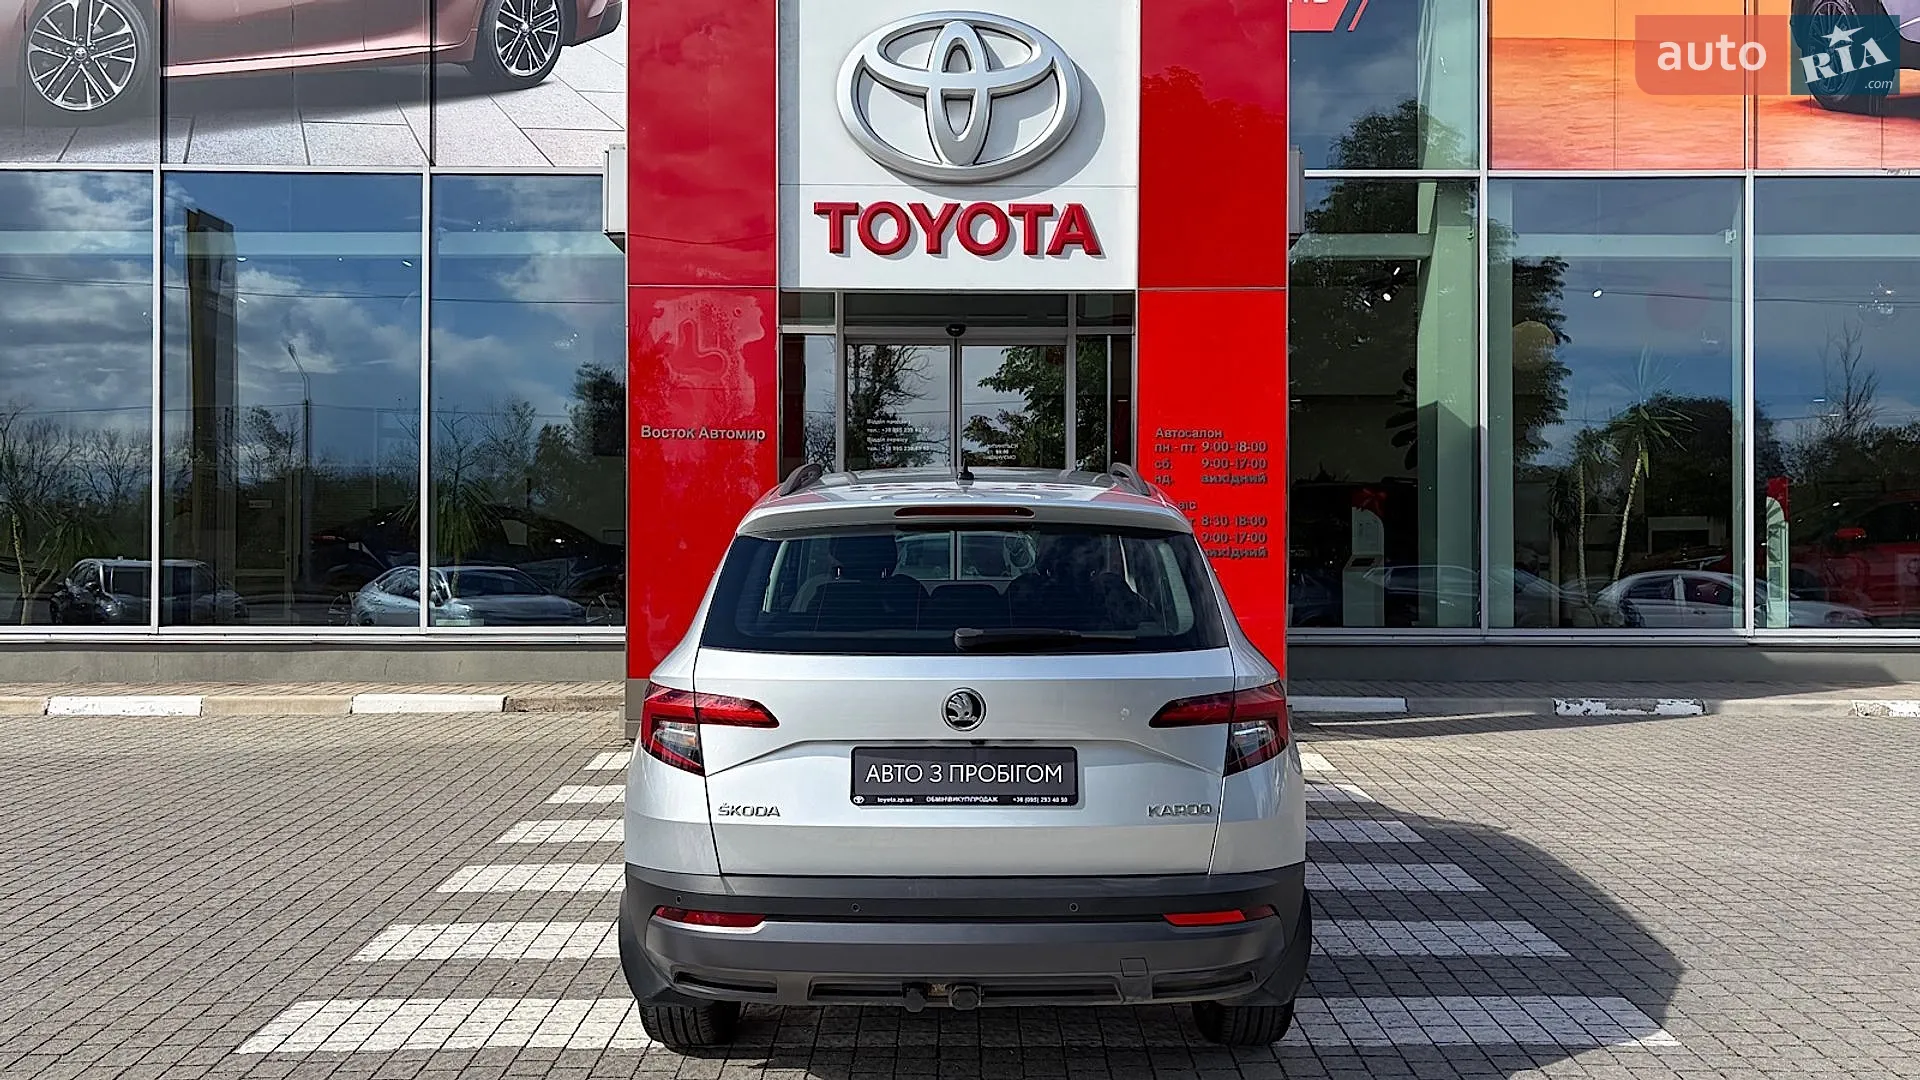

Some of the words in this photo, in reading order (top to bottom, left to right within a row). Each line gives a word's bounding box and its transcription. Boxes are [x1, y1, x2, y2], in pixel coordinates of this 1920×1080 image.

[814, 201, 1102, 256] TOYOTA
[641, 425, 695, 439] Восток
[699, 426, 766, 442] Автомир
[1155, 427, 1223, 439] Автосалон
[865, 764, 923, 783] АВТО
[929, 764, 943, 783] З
[950, 764, 1063, 783] ПРОБІГОМ
[718, 803, 781, 817] ŠKODA
